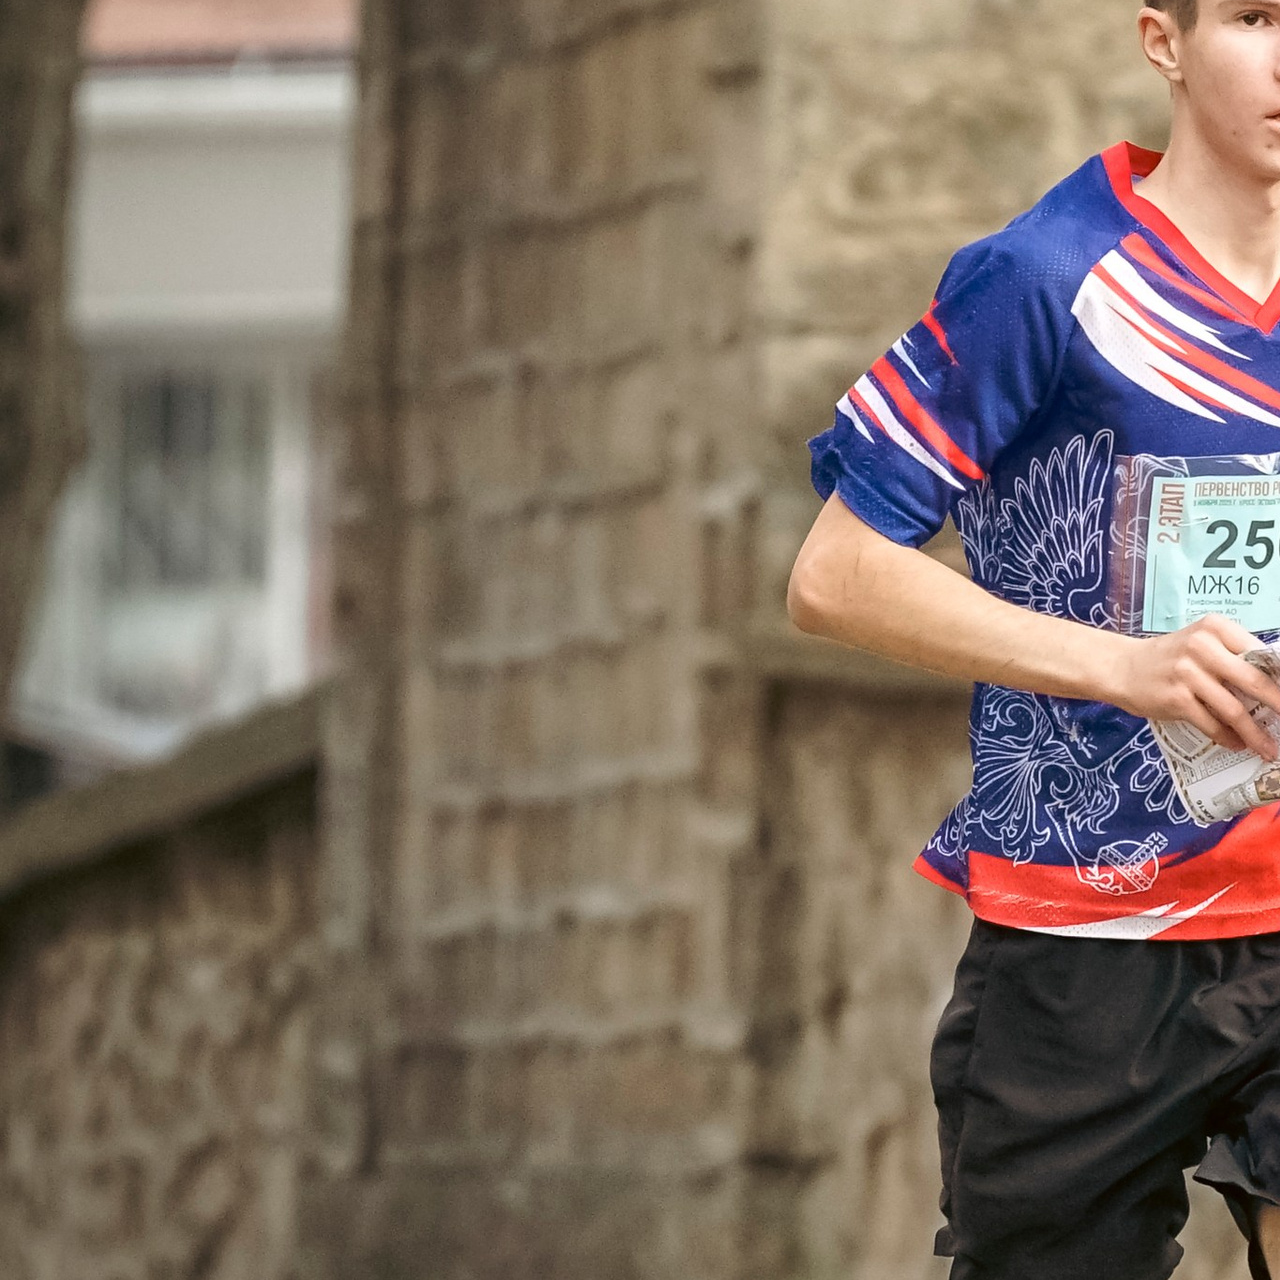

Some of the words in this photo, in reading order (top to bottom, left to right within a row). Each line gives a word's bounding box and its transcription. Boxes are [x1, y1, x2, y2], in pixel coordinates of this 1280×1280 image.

[1194, 481, 1270, 497] ПЕРВЕНСТВО
[1158, 483, 1185, 527] ЭТАП
[1157, 532, 1180, 544] 2
[1188, 575, 1260, 595] МЖ16
